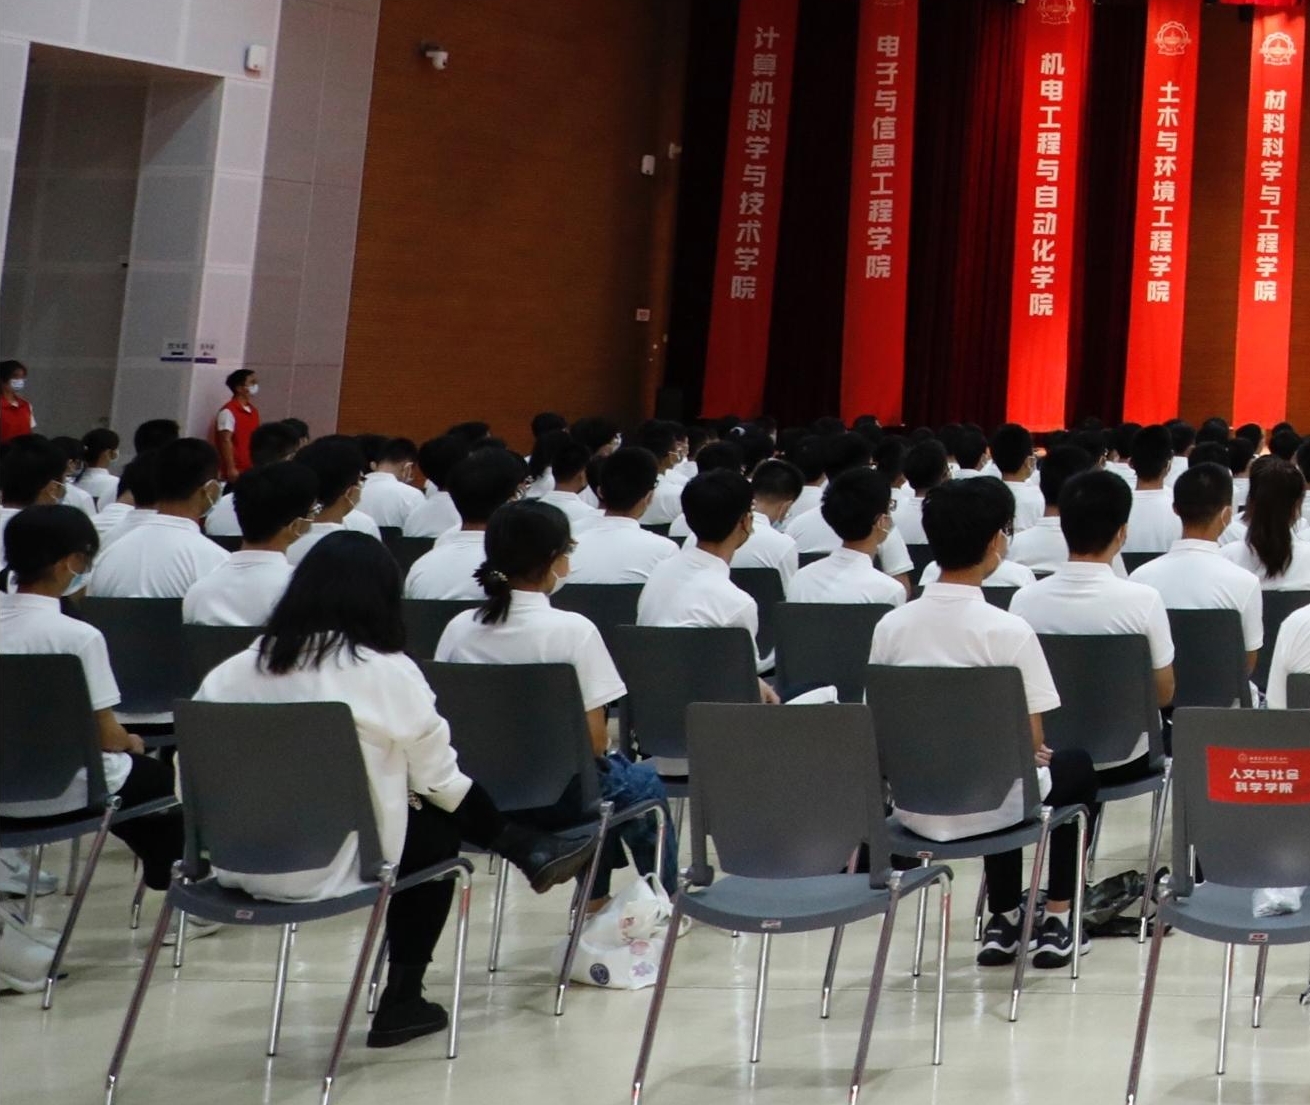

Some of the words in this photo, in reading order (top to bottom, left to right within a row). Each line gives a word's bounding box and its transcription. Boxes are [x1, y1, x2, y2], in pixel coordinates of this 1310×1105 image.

[730, 26, 780, 300] 计算机科学与技术学院
[865, 34, 901, 280] 电子与信息工程学院
[1028, 52, 1066, 317] 机电工程与自动化学院
[1147, 81, 1181, 303] 土木与环境工程学院
[1253, 89, 1287, 302] 材料科学与工程学院
[1229, 767, 1300, 780] 人文与社会
[1235, 781, 1294, 794] 科学学院
